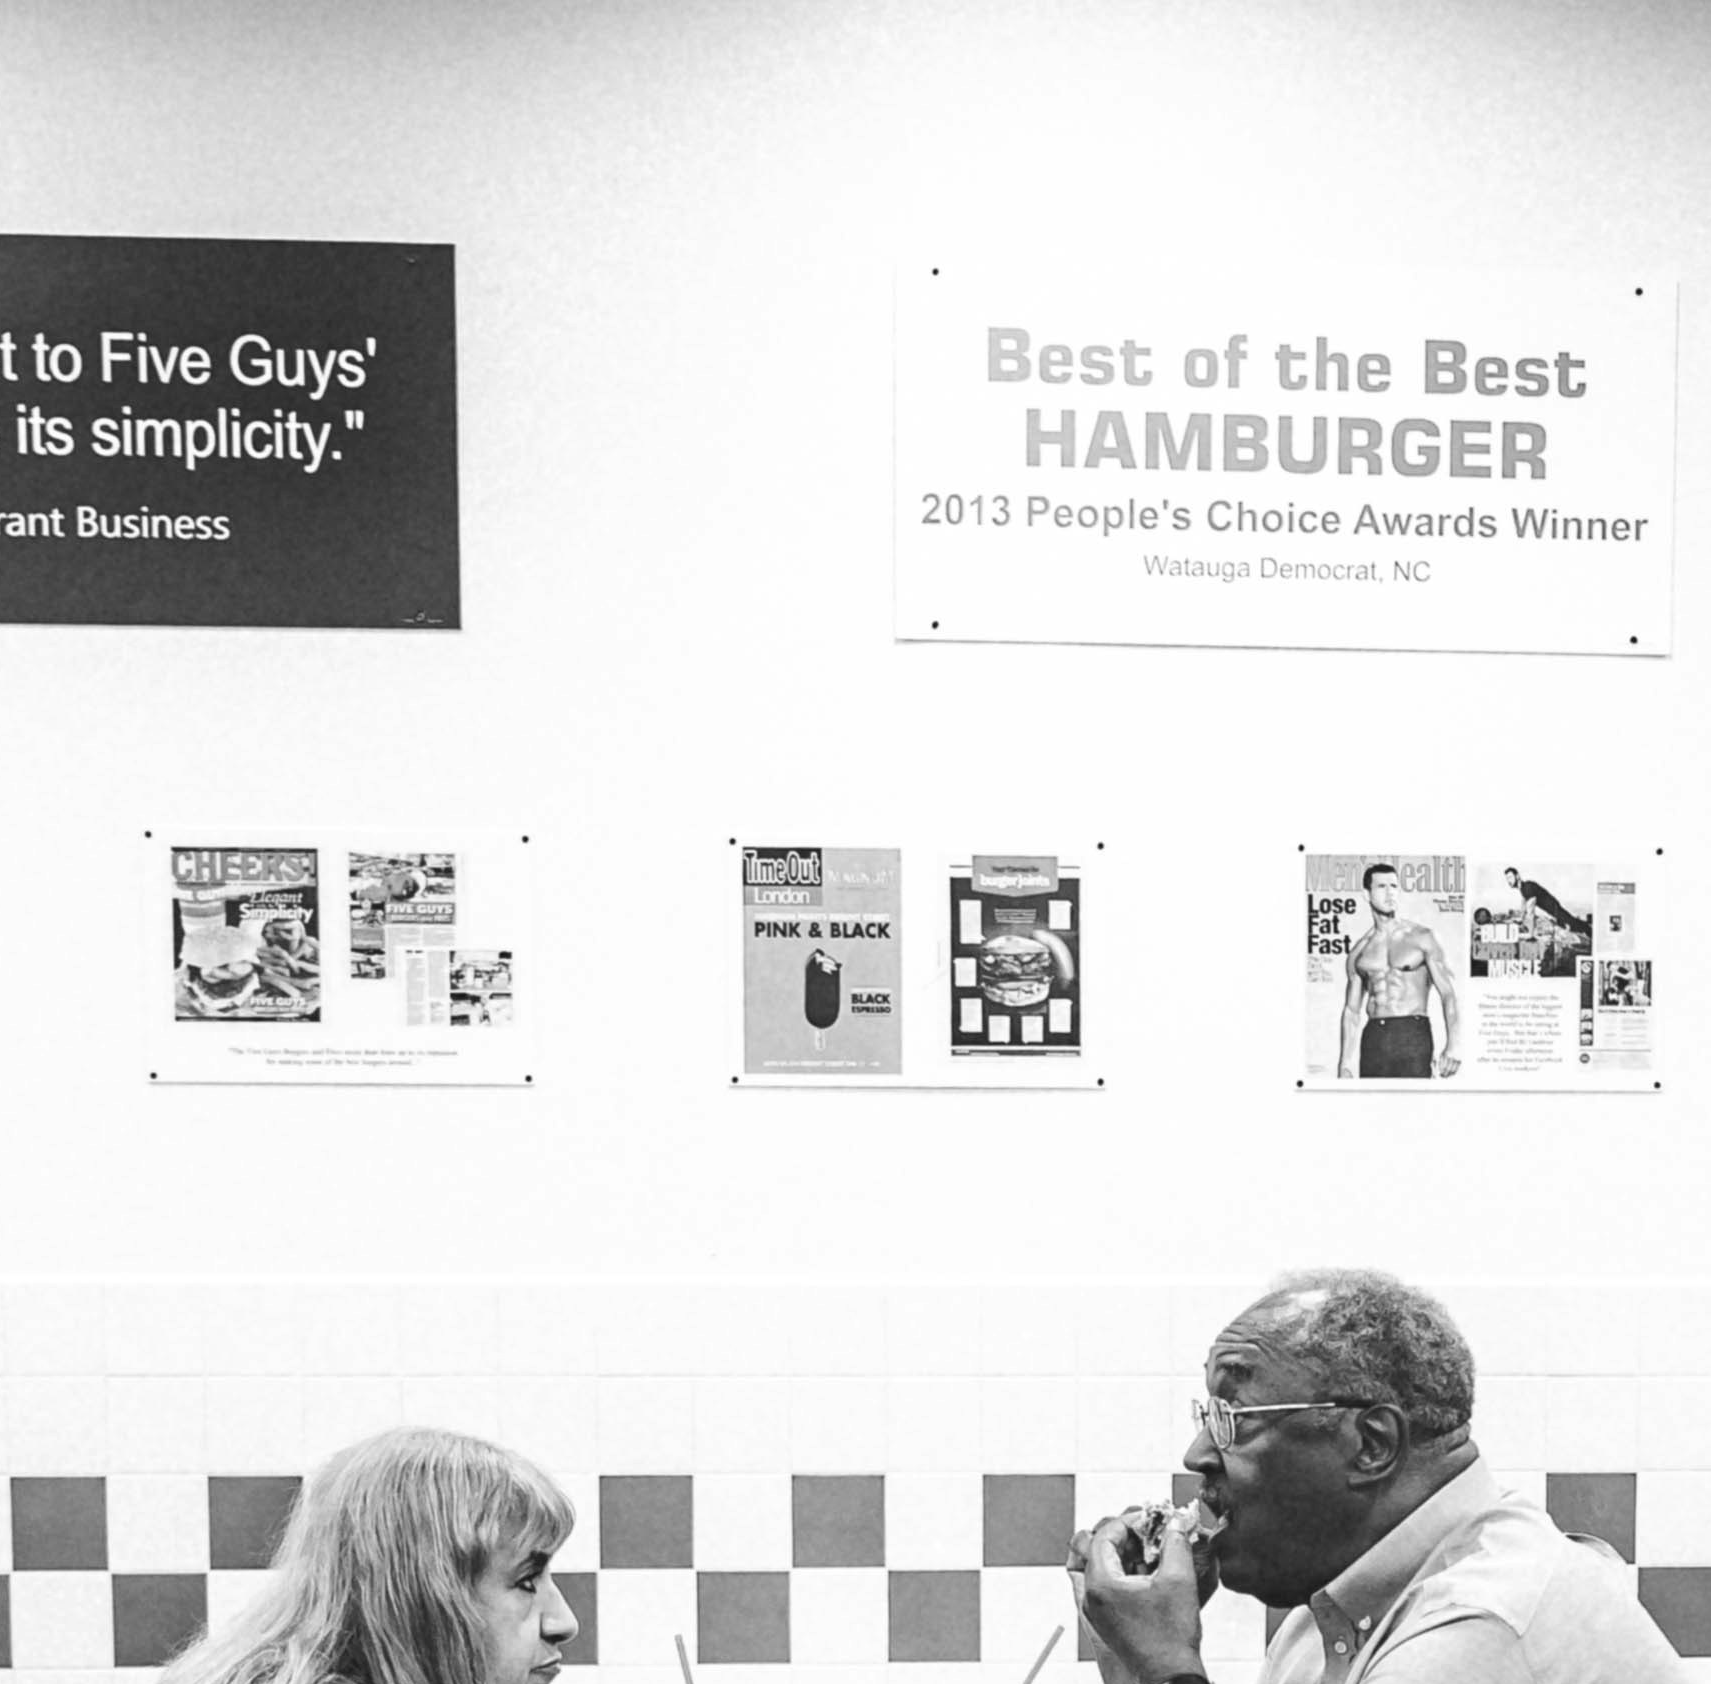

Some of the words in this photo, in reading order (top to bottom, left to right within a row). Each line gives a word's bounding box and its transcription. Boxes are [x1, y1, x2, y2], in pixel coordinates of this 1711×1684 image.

[32, 333, 82, 382] to
[101, 332, 211, 384] Five
[230, 335, 376, 400] Guys'
[988, 327, 1152, 386] Best
[1184, 334, 1247, 388] of
[1275, 337, 1391, 392] the
[1425, 340, 1586, 398] Best
[17, 404, 74, 455] its
[92, 406, 364, 473] simplicity."
[1027, 409, 1546, 480] HAMBURGER
[77, 506, 230, 540] Business
[922, 493, 1010, 526] 2013
[1028, 496, 1191, 537] People's
[1208, 501, 1340, 534] Choice
[1354, 505, 1497, 538] Awards
[1512, 508, 1648, 541] Winner
[1144, 555, 1250, 583] Watauga
[1261, 557, 1384, 584] Democrat,
[1394, 561, 1430, 582] NC
[744, 850, 786, 884] Time
[786, 850, 821, 884] Out
[754, 888, 810, 904] London
[1308, 894, 1356, 915] Lose
[754, 922, 802, 938] PINK
[808, 922, 823, 938] &
[830, 922, 891, 939] BLACK
[1308, 915, 1340, 934] Fat
[1308, 935, 1351, 954] Fast
[851, 993, 890, 1004] BLACK
